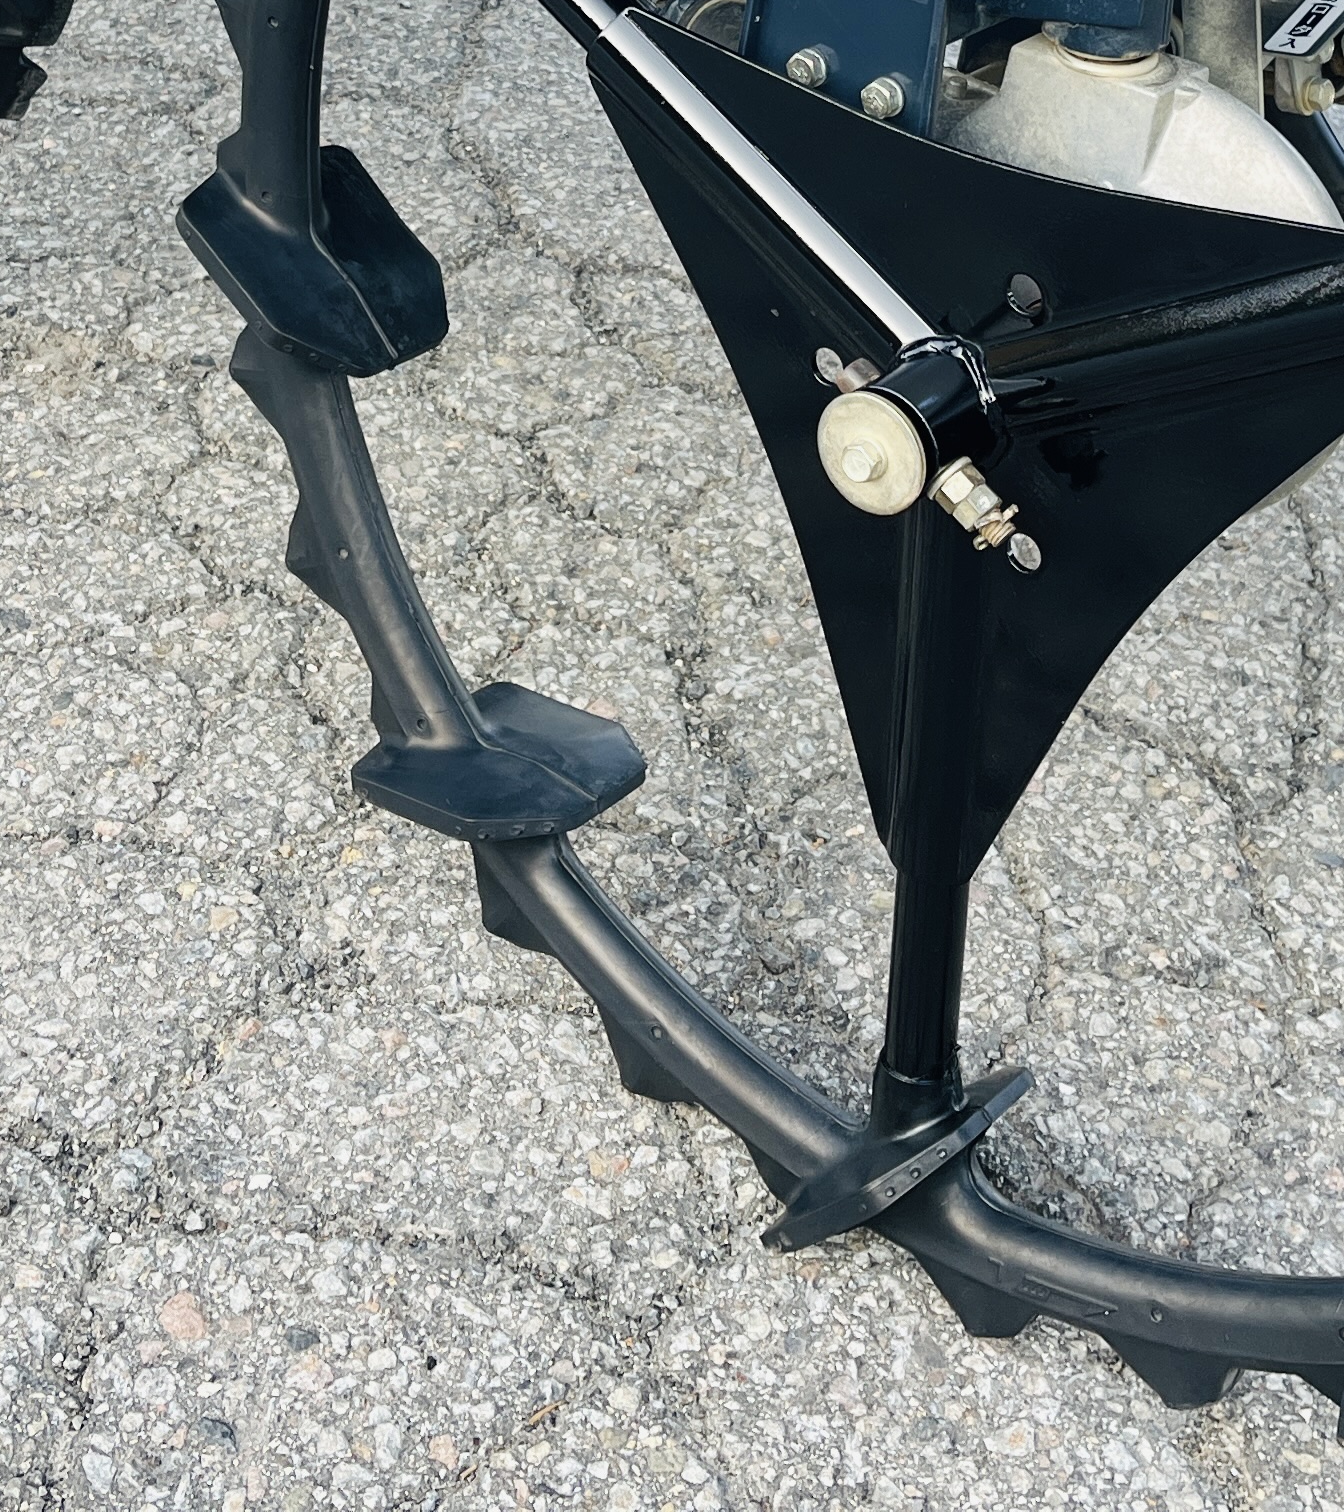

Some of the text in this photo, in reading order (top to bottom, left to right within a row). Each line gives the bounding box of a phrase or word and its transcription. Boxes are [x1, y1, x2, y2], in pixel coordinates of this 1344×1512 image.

[1291, 3, 1331, 36] ロータ
[1278, 37, 1296, 49] 入
